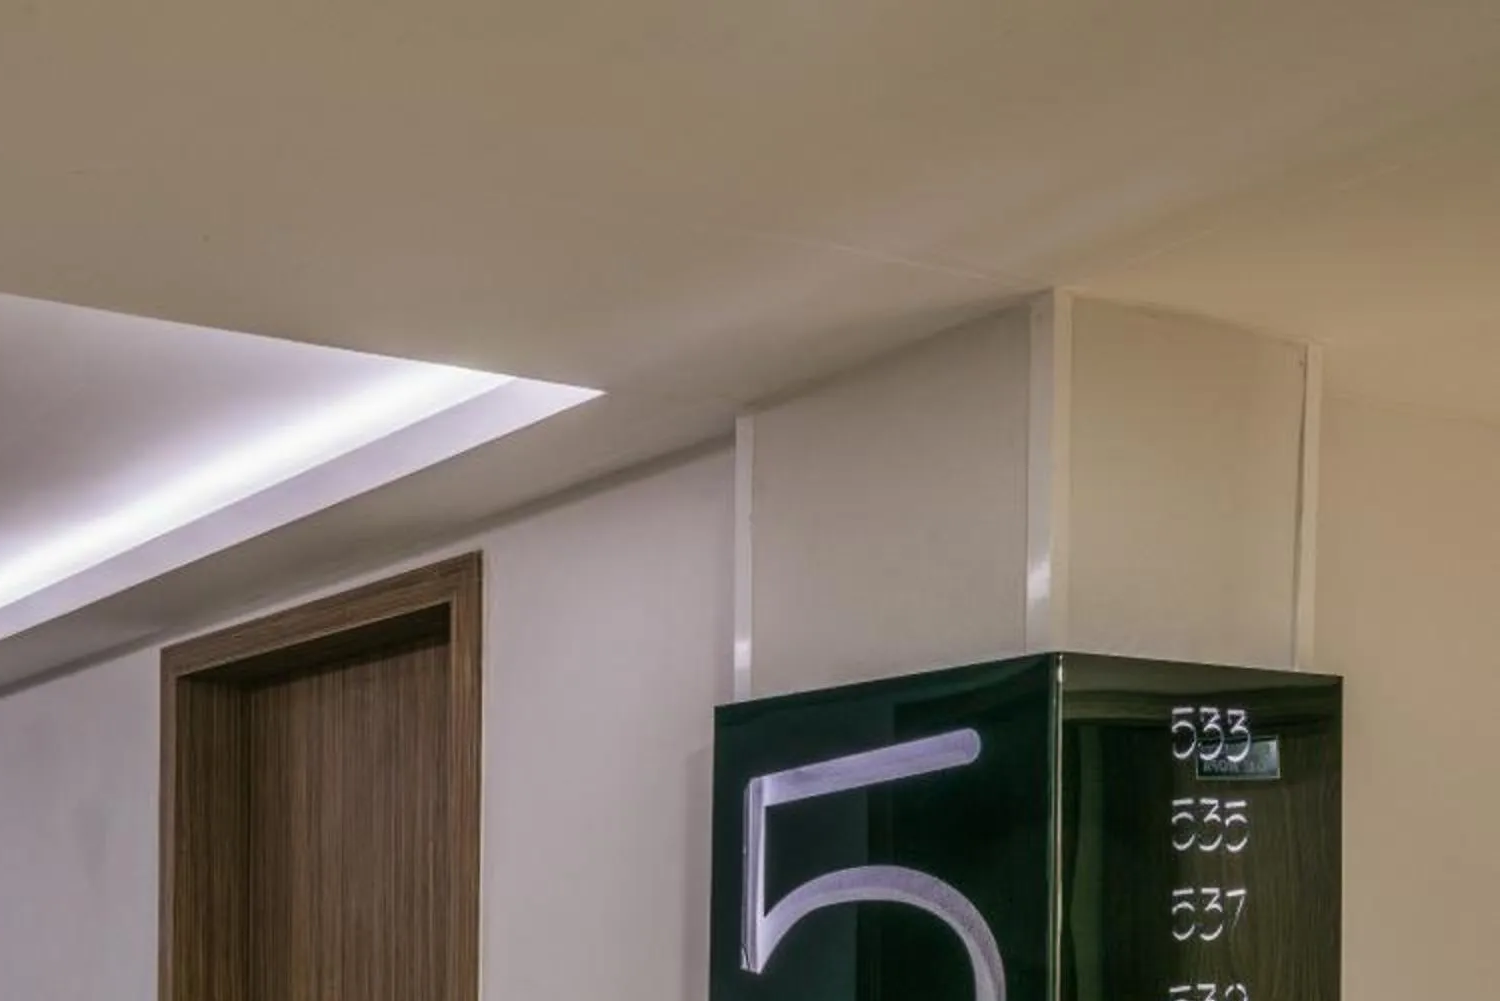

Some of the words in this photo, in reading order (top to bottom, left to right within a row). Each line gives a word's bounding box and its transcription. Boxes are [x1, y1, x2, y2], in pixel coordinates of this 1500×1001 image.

[1171, 706, 1250, 762] 533
[1171, 798, 1248, 851] 535
[1171, 888, 1247, 941] 537
